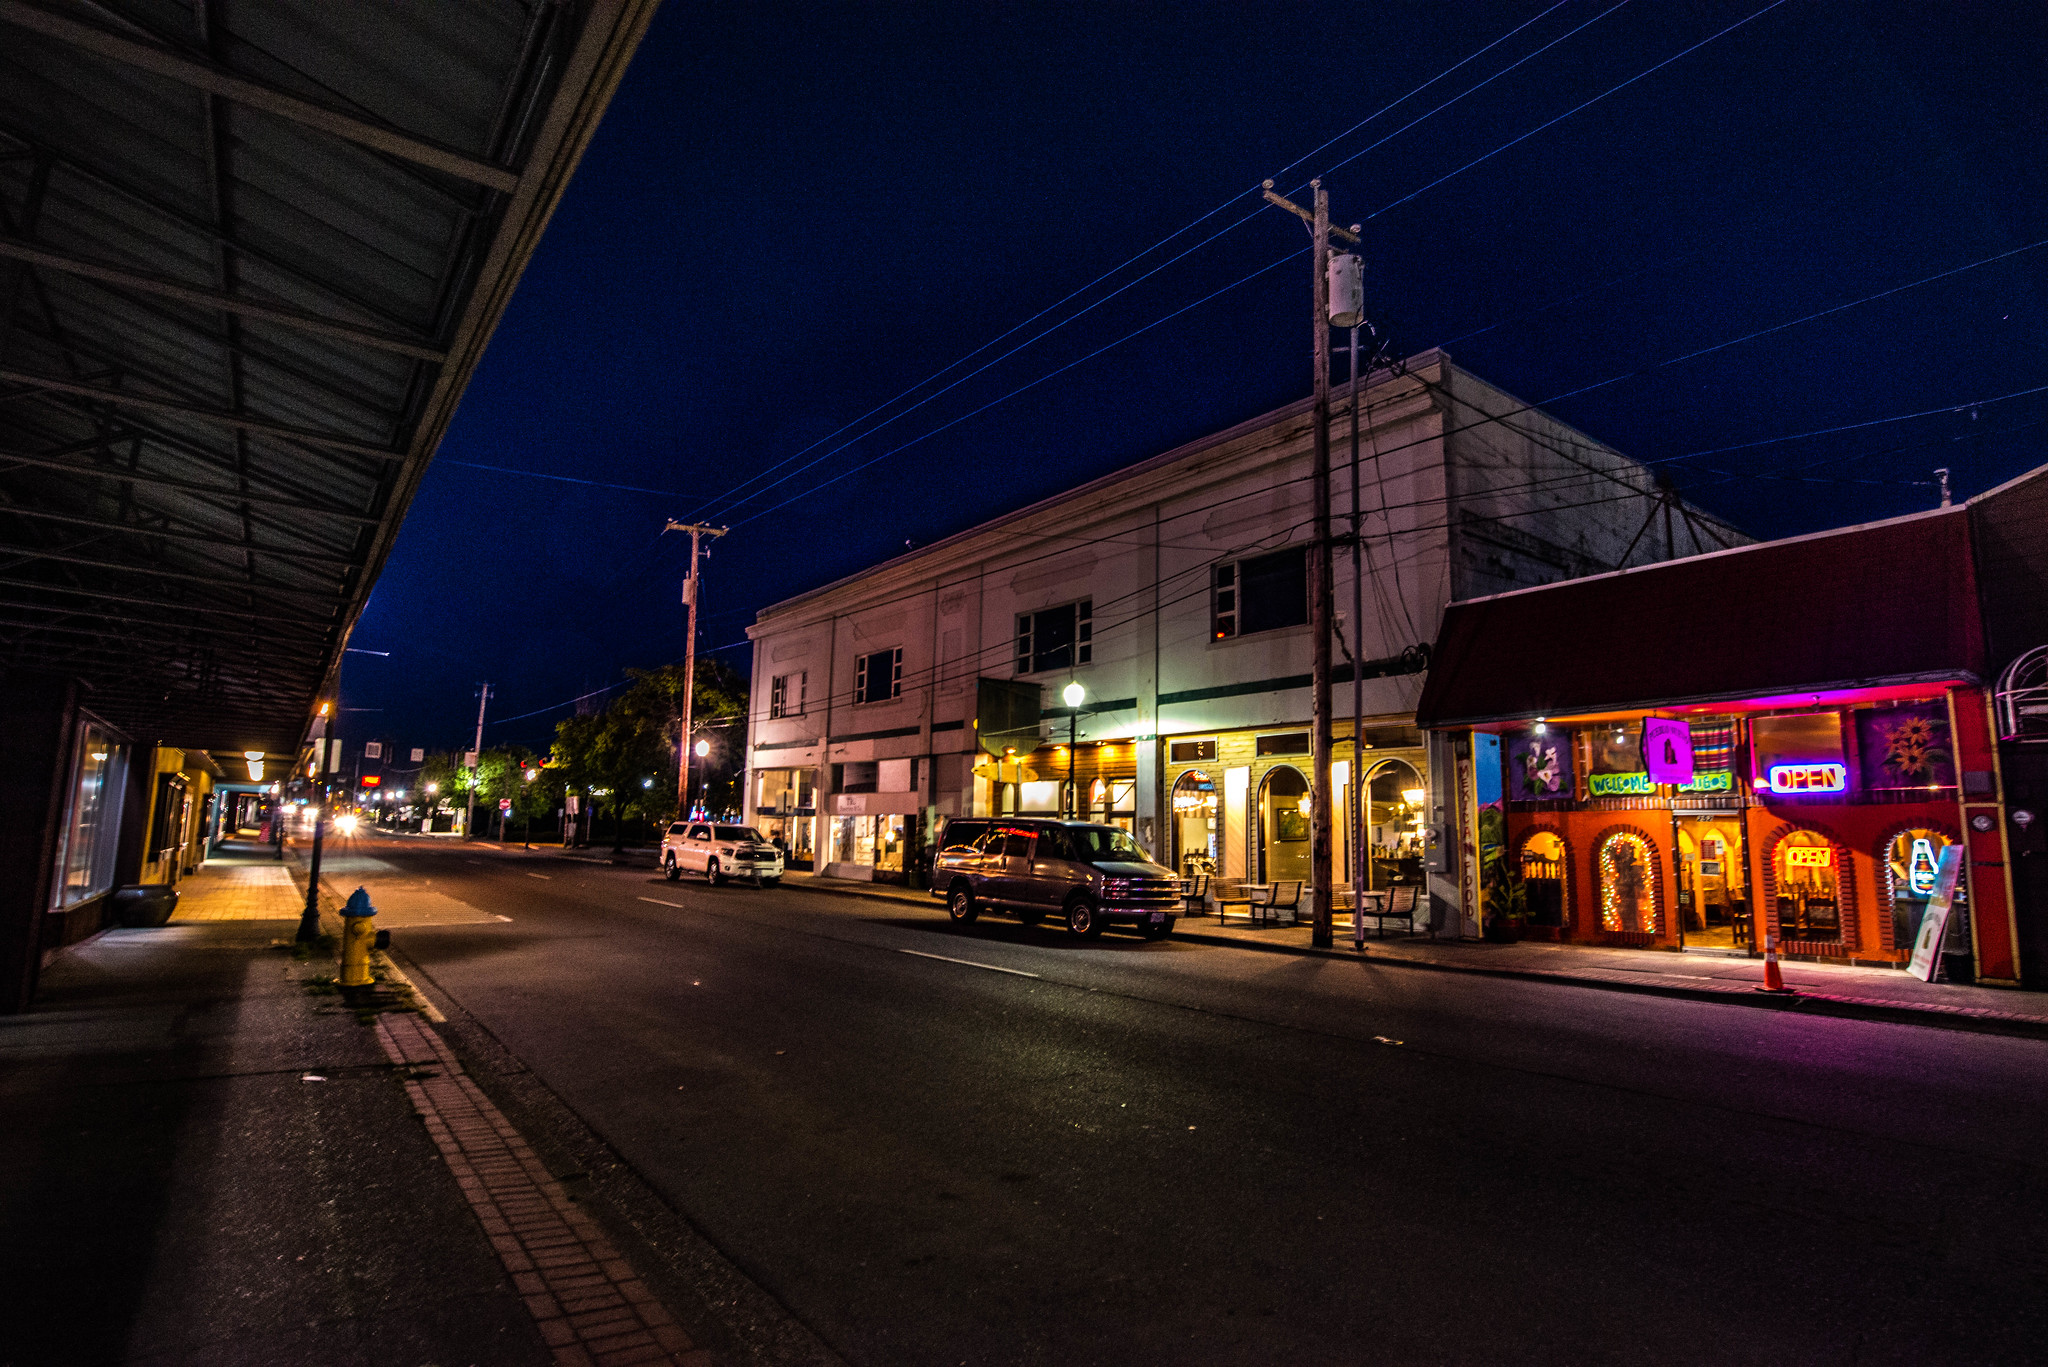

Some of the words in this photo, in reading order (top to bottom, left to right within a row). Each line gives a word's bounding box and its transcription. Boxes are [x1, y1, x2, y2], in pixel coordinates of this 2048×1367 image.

[1593, 774, 1650, 792] WELCOME
[1774, 766, 1838, 789] OPEN
[1459, 764, 1473, 856] MEXICAN
[1788, 849, 1829, 865] OPEN
[1463, 861, 1474, 918] FOOD
